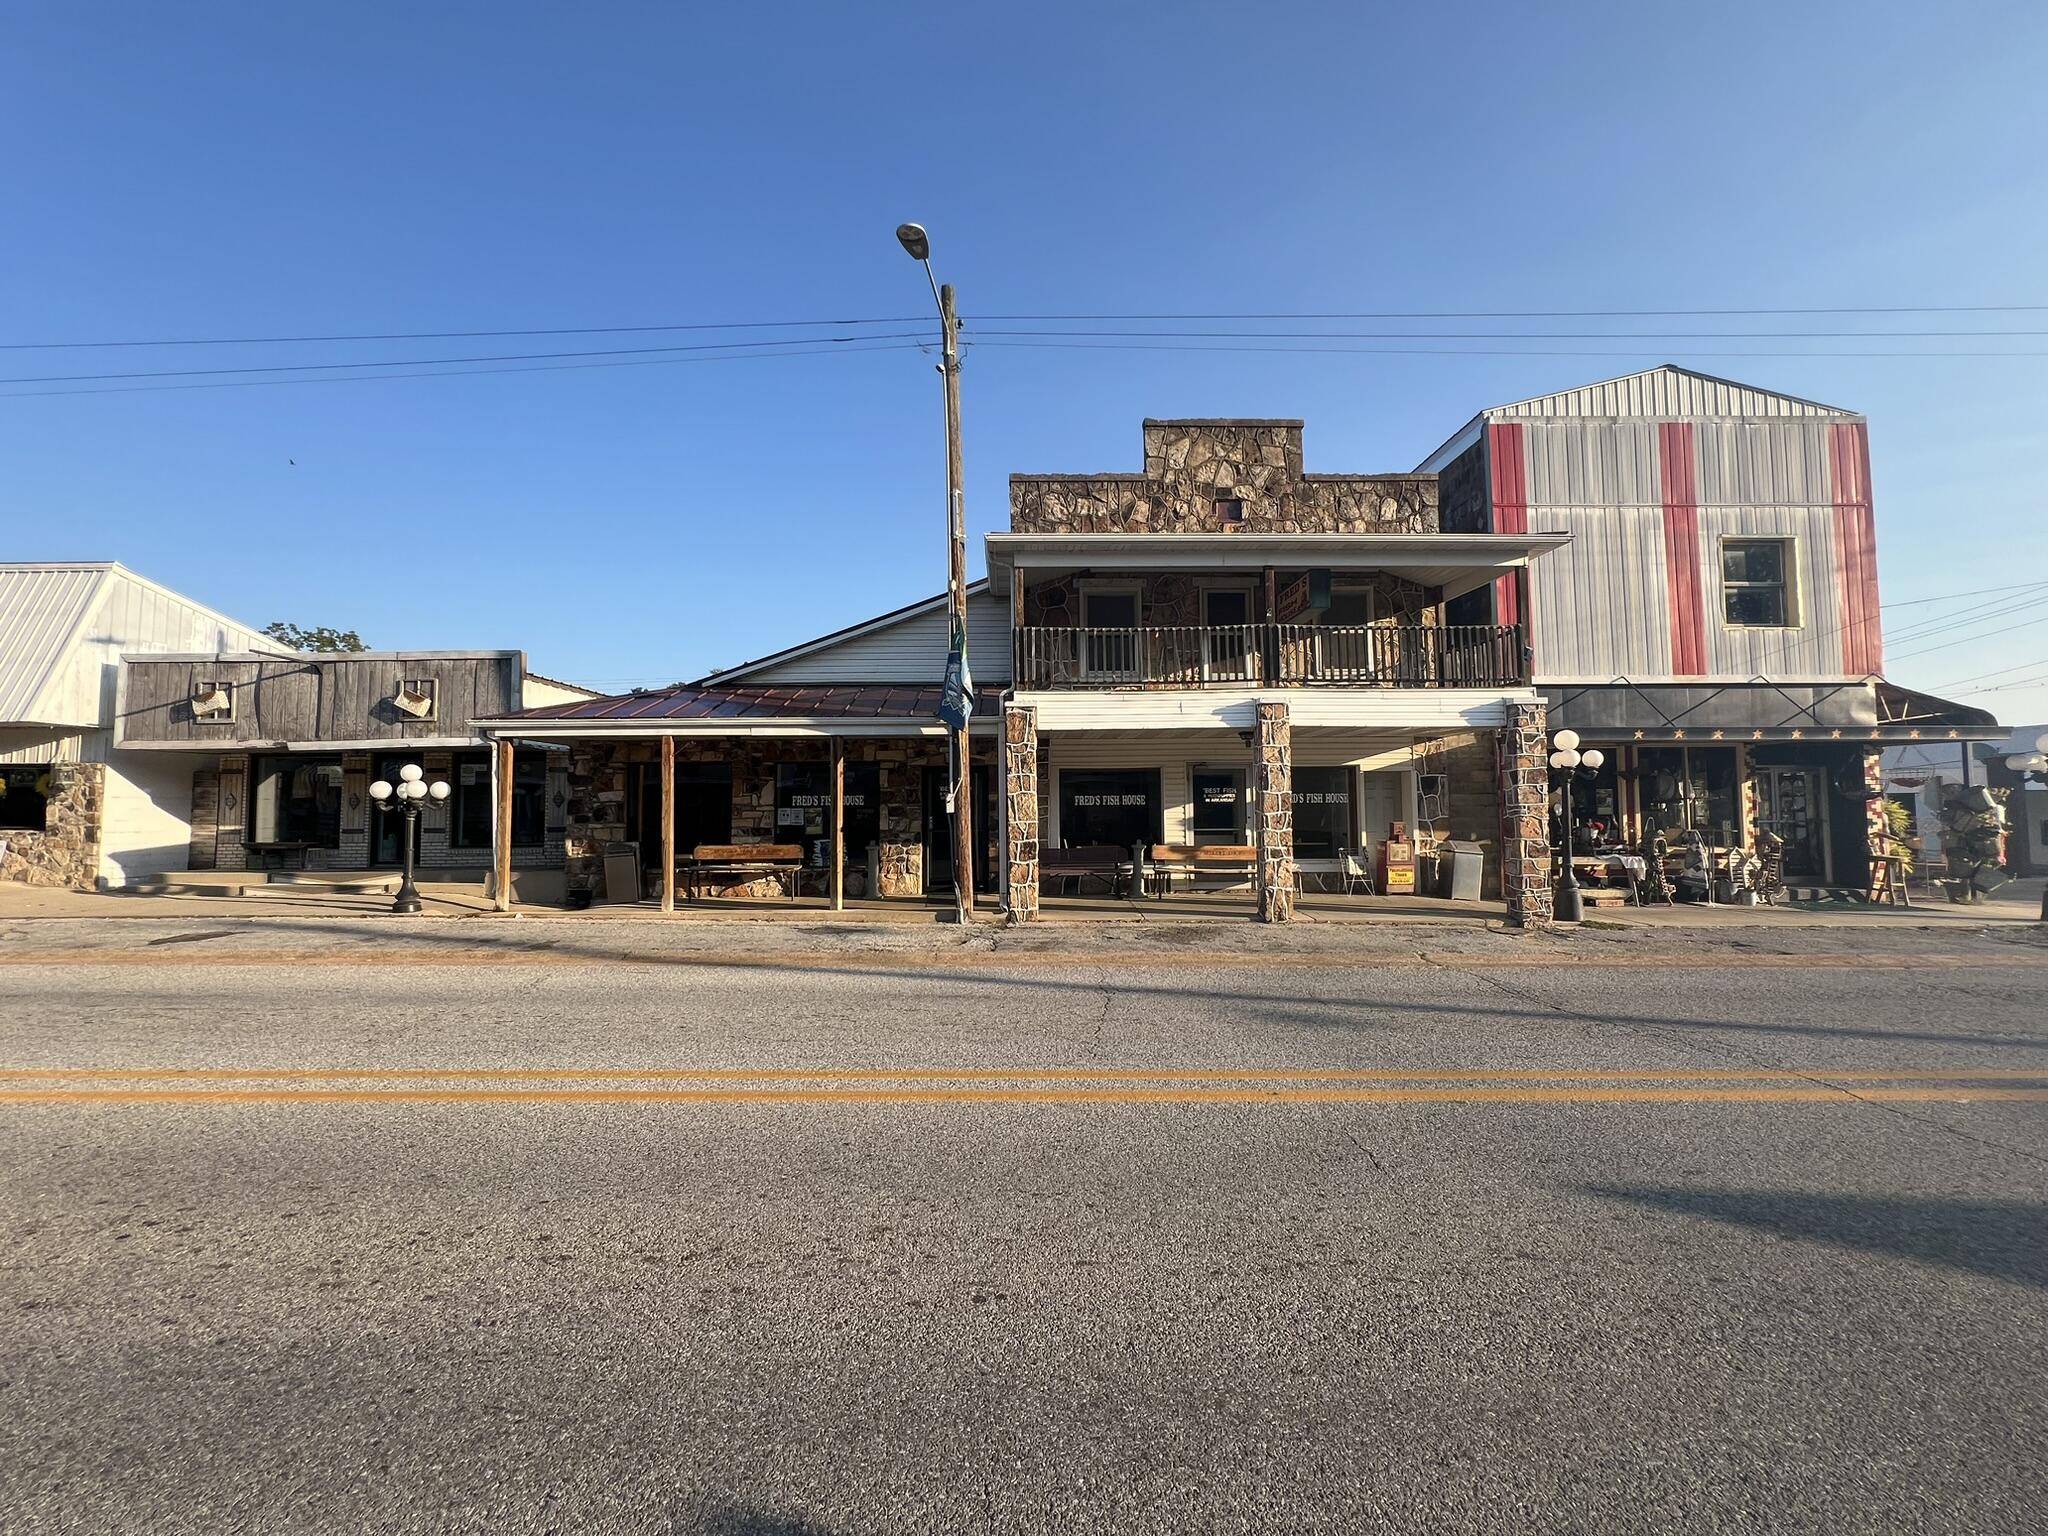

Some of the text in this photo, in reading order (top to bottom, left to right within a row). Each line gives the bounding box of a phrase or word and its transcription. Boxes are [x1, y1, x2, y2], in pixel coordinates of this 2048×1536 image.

[792, 795, 819, 806] FRED'S
[820, 795, 832, 806] FIS
[1074, 794, 1146, 806] FRED'S FISH HOUSE
[1306, 793, 1323, 804] FISH
[1325, 793, 1349, 804] HOUSE
